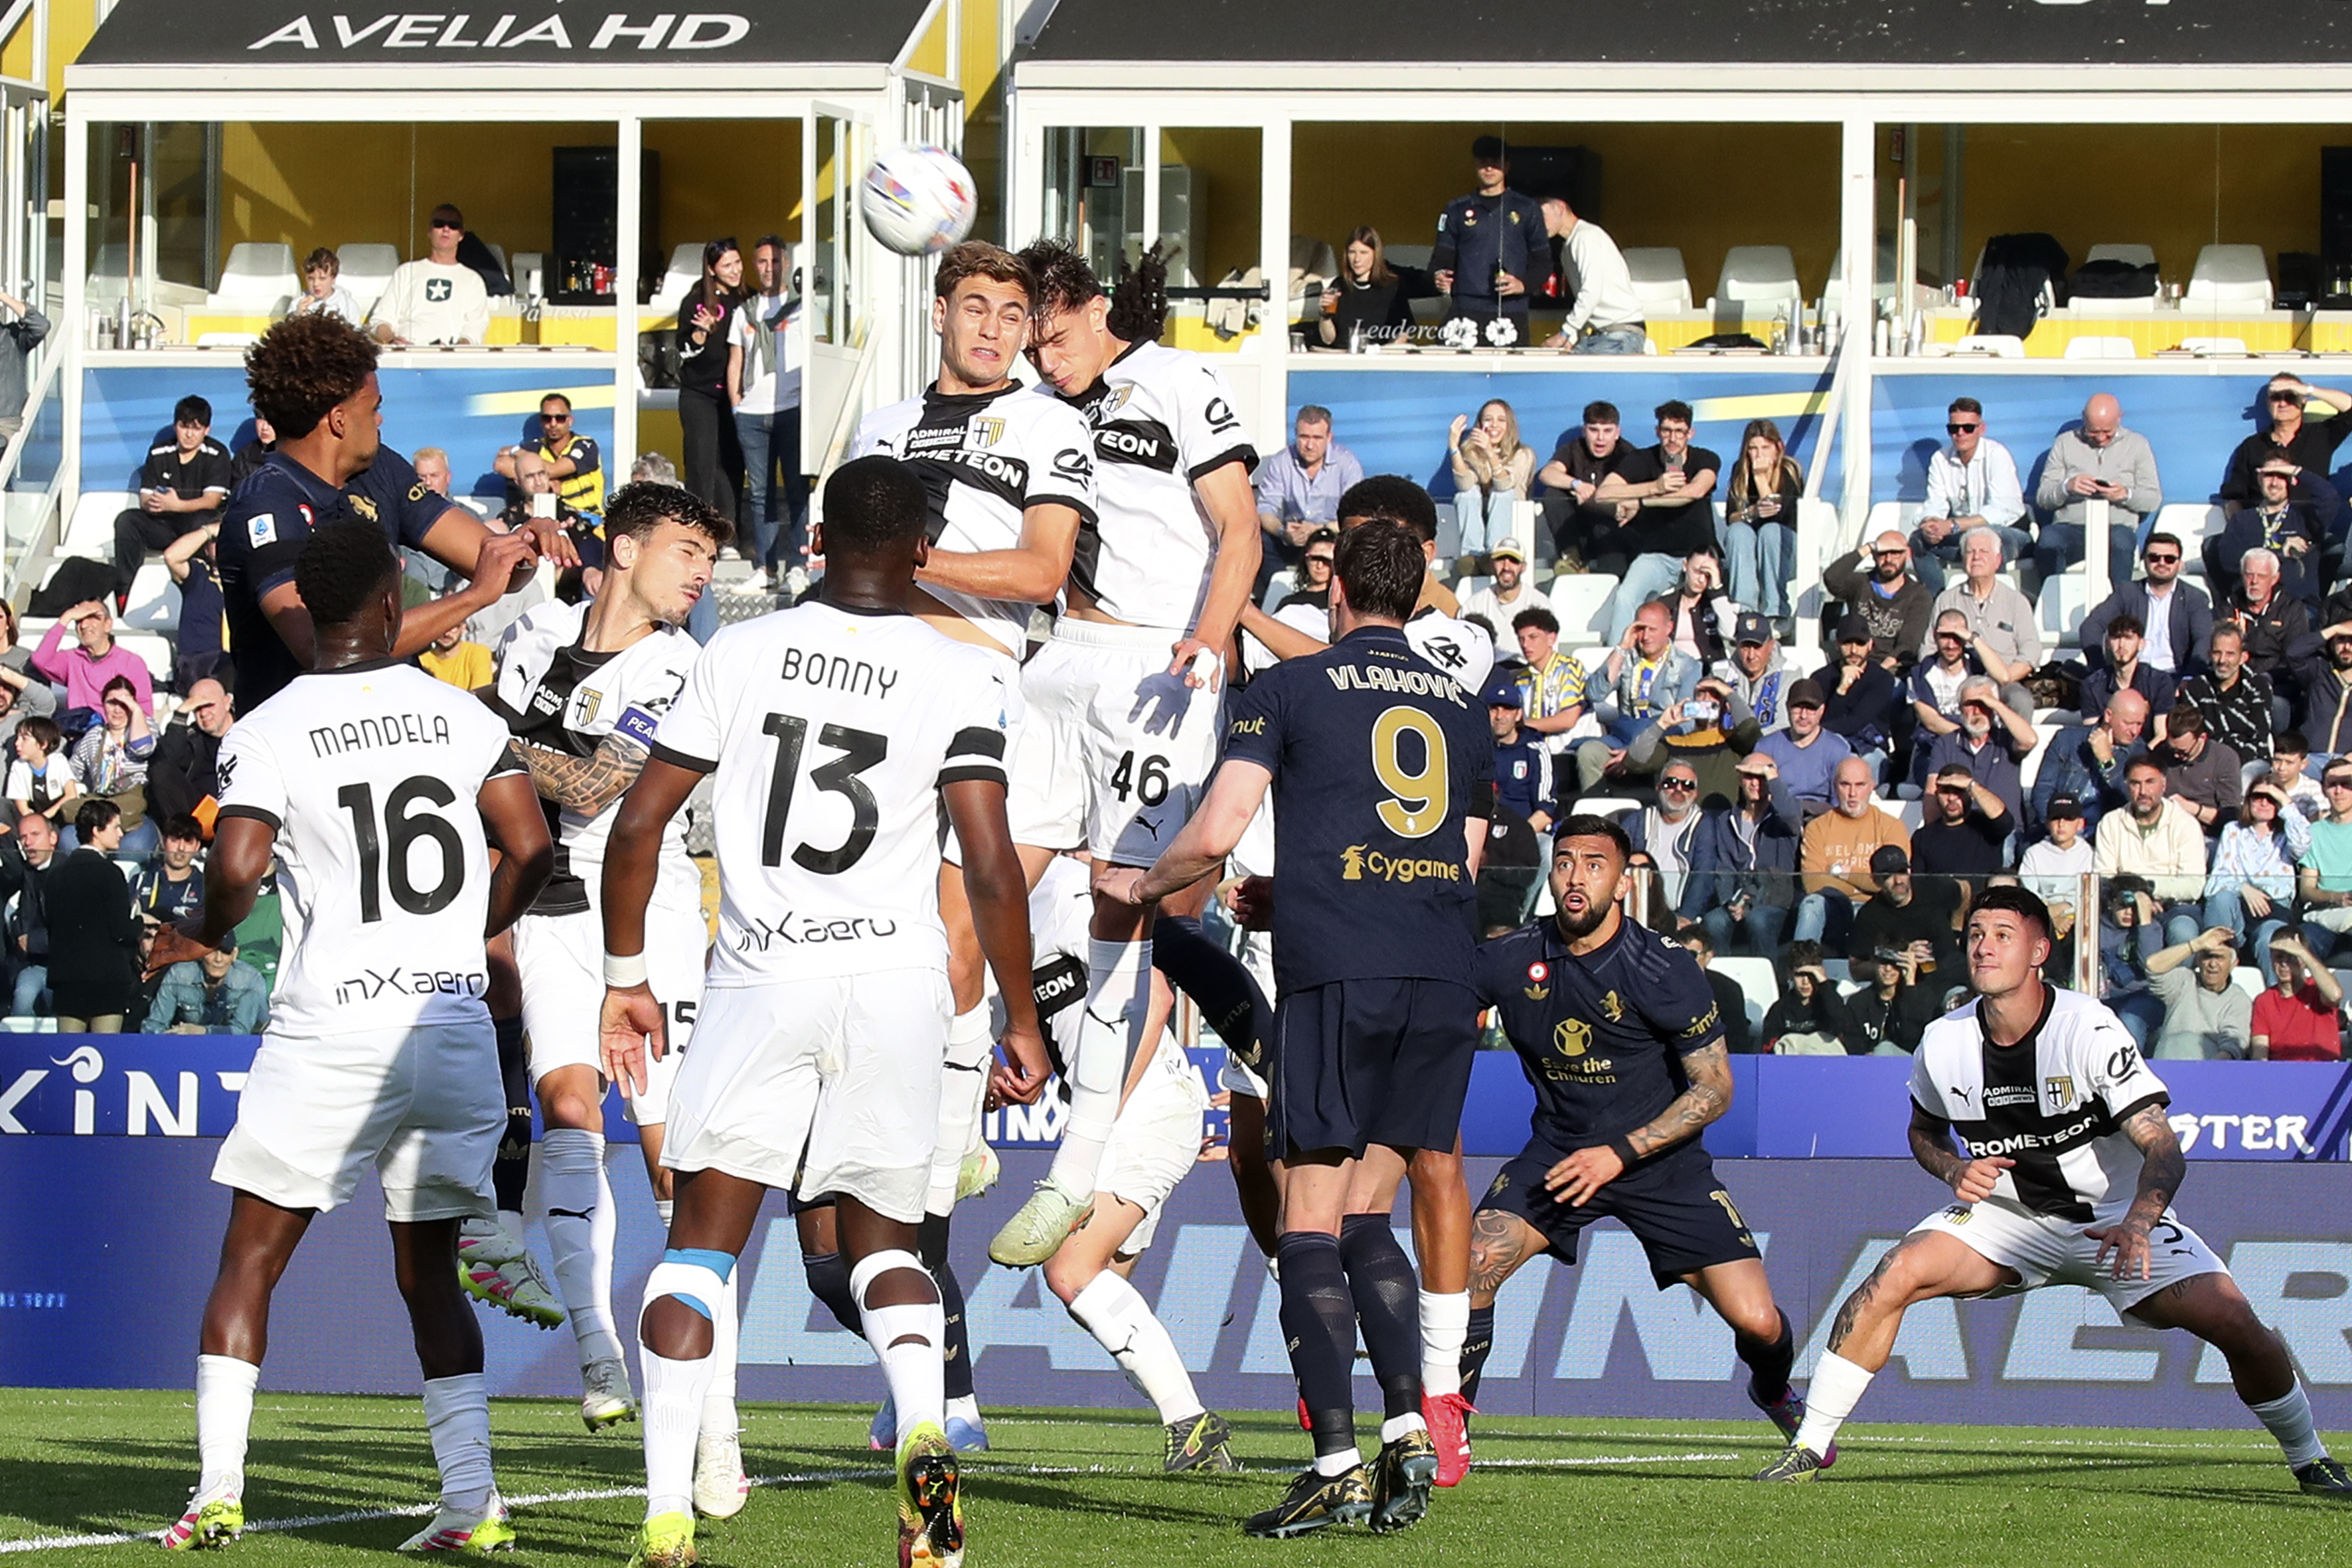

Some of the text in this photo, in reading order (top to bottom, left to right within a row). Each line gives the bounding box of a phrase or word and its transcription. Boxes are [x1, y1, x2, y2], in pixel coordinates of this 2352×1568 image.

[247, 14, 751, 49] AVELIA HD
[907, 426, 967, 441] ADMIRAL
[781, 647, 898, 699] BONNY
[309, 714, 450, 758] MANDELA
[627, 716, 655, 741] PEA
[1111, 750, 1170, 807] 46
[1372, 706, 1449, 838] 9
[762, 712, 888, 875] 13
[338, 775, 465, 923] 16
[1368, 851, 1460, 885] Cygame
[1863, 1022, 1879, 1040] 10
[1583, 1057, 1612, 1073] the
[1982, 1085, 2037, 1098] ADMIRAL
